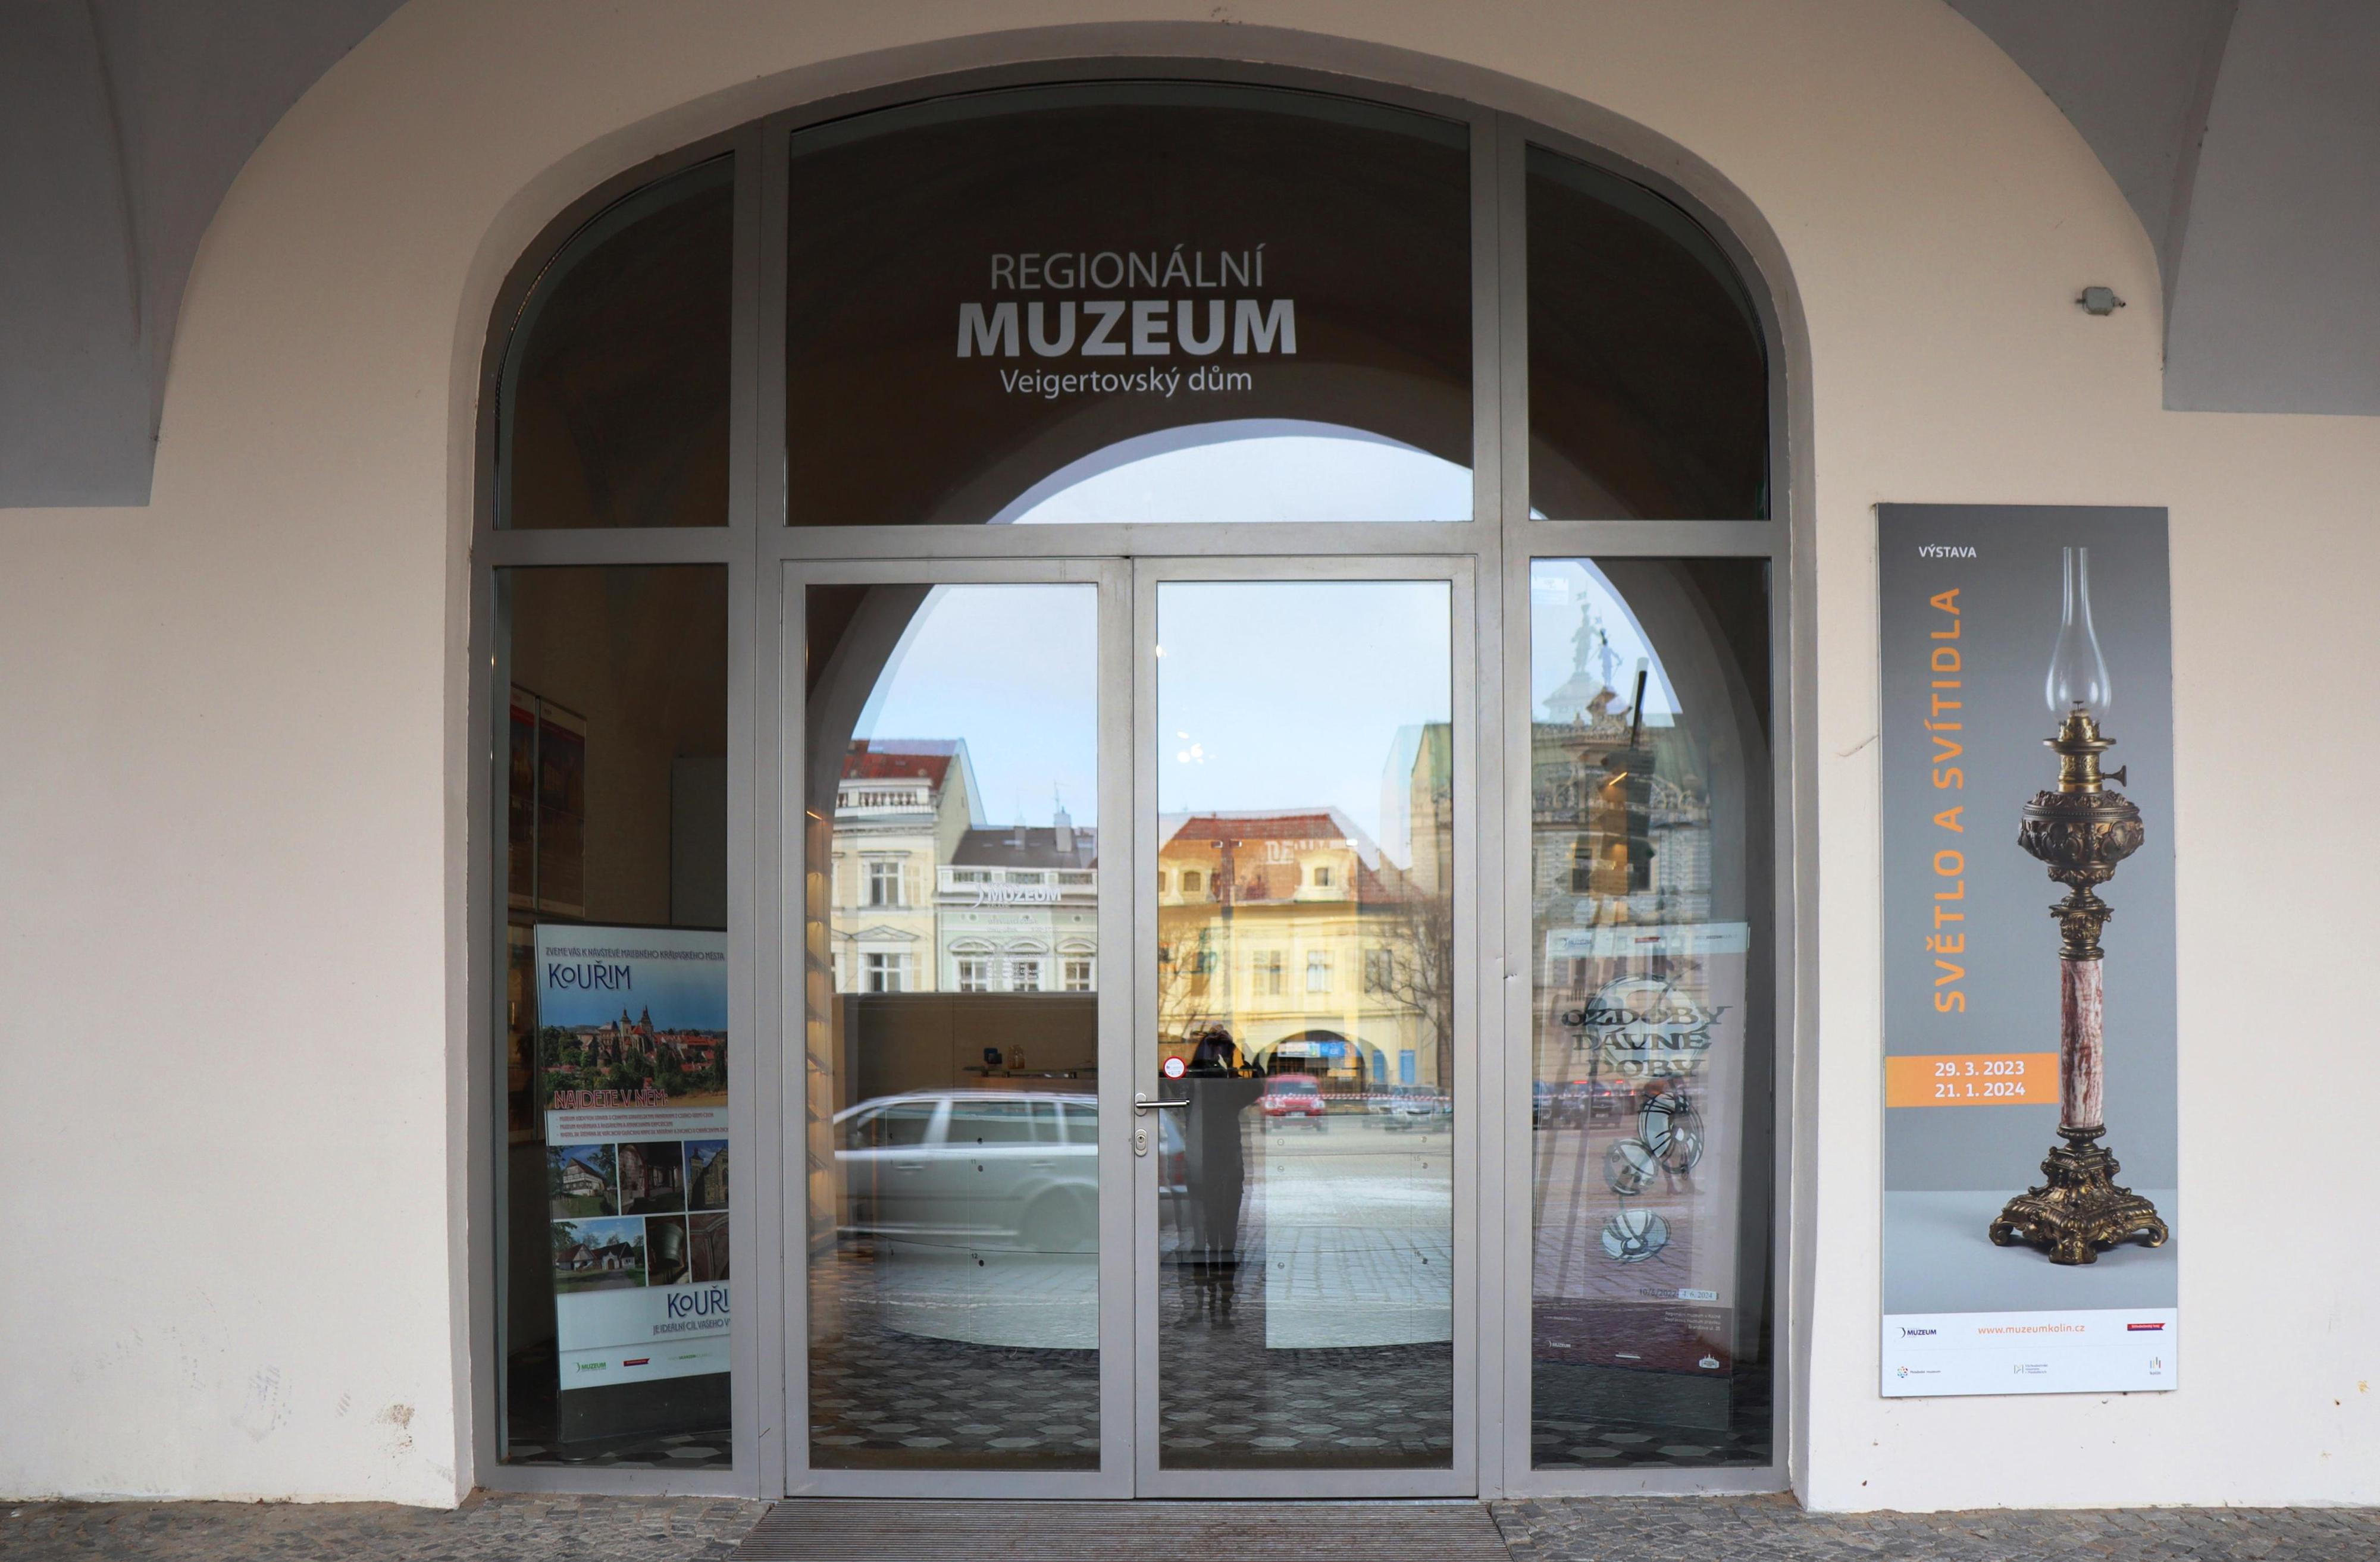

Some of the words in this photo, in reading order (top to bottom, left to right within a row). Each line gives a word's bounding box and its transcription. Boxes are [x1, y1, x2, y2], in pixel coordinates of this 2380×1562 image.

[991, 243, 1266, 290] REGIONÁLNÍ
[957, 299, 1297, 357] MUZEUM
[1000, 366, 1180, 399] Veigertovský
[1188, 366, 1252, 391] dům
[1918, 544, 1977, 558] VÝSTAVA
[1924, 588, 1964, 789] SVÍTIDLA
[1934, 806, 1964, 833] A
[988, 889, 1061, 902] MUZEUM
[1926, 850, 1965, 1012] SVĚTLO
[1561, 1006, 1733, 1027] OZDOBY
[1587, 1059, 1706, 1078] DOBY
[1935, 1062, 1960, 1076] 29.
[1965, 1062, 1979, 1075] 3.
[1983, 1061, 2024, 1075] 2023
[554, 1090, 618, 1110] NAJDETE
[621, 1089, 631, 1108] V
[1935, 1083, 1961, 1097] 21.
[1966, 1083, 1979, 1097] 1.
[1983, 1082, 2025, 1096] 2024
[666, 1285, 729, 1318] KOUŘI
[1978, 1323, 2085, 1334] www.muzeumkolin.cz
[581, 1362, 606, 1370] MUZEUM
